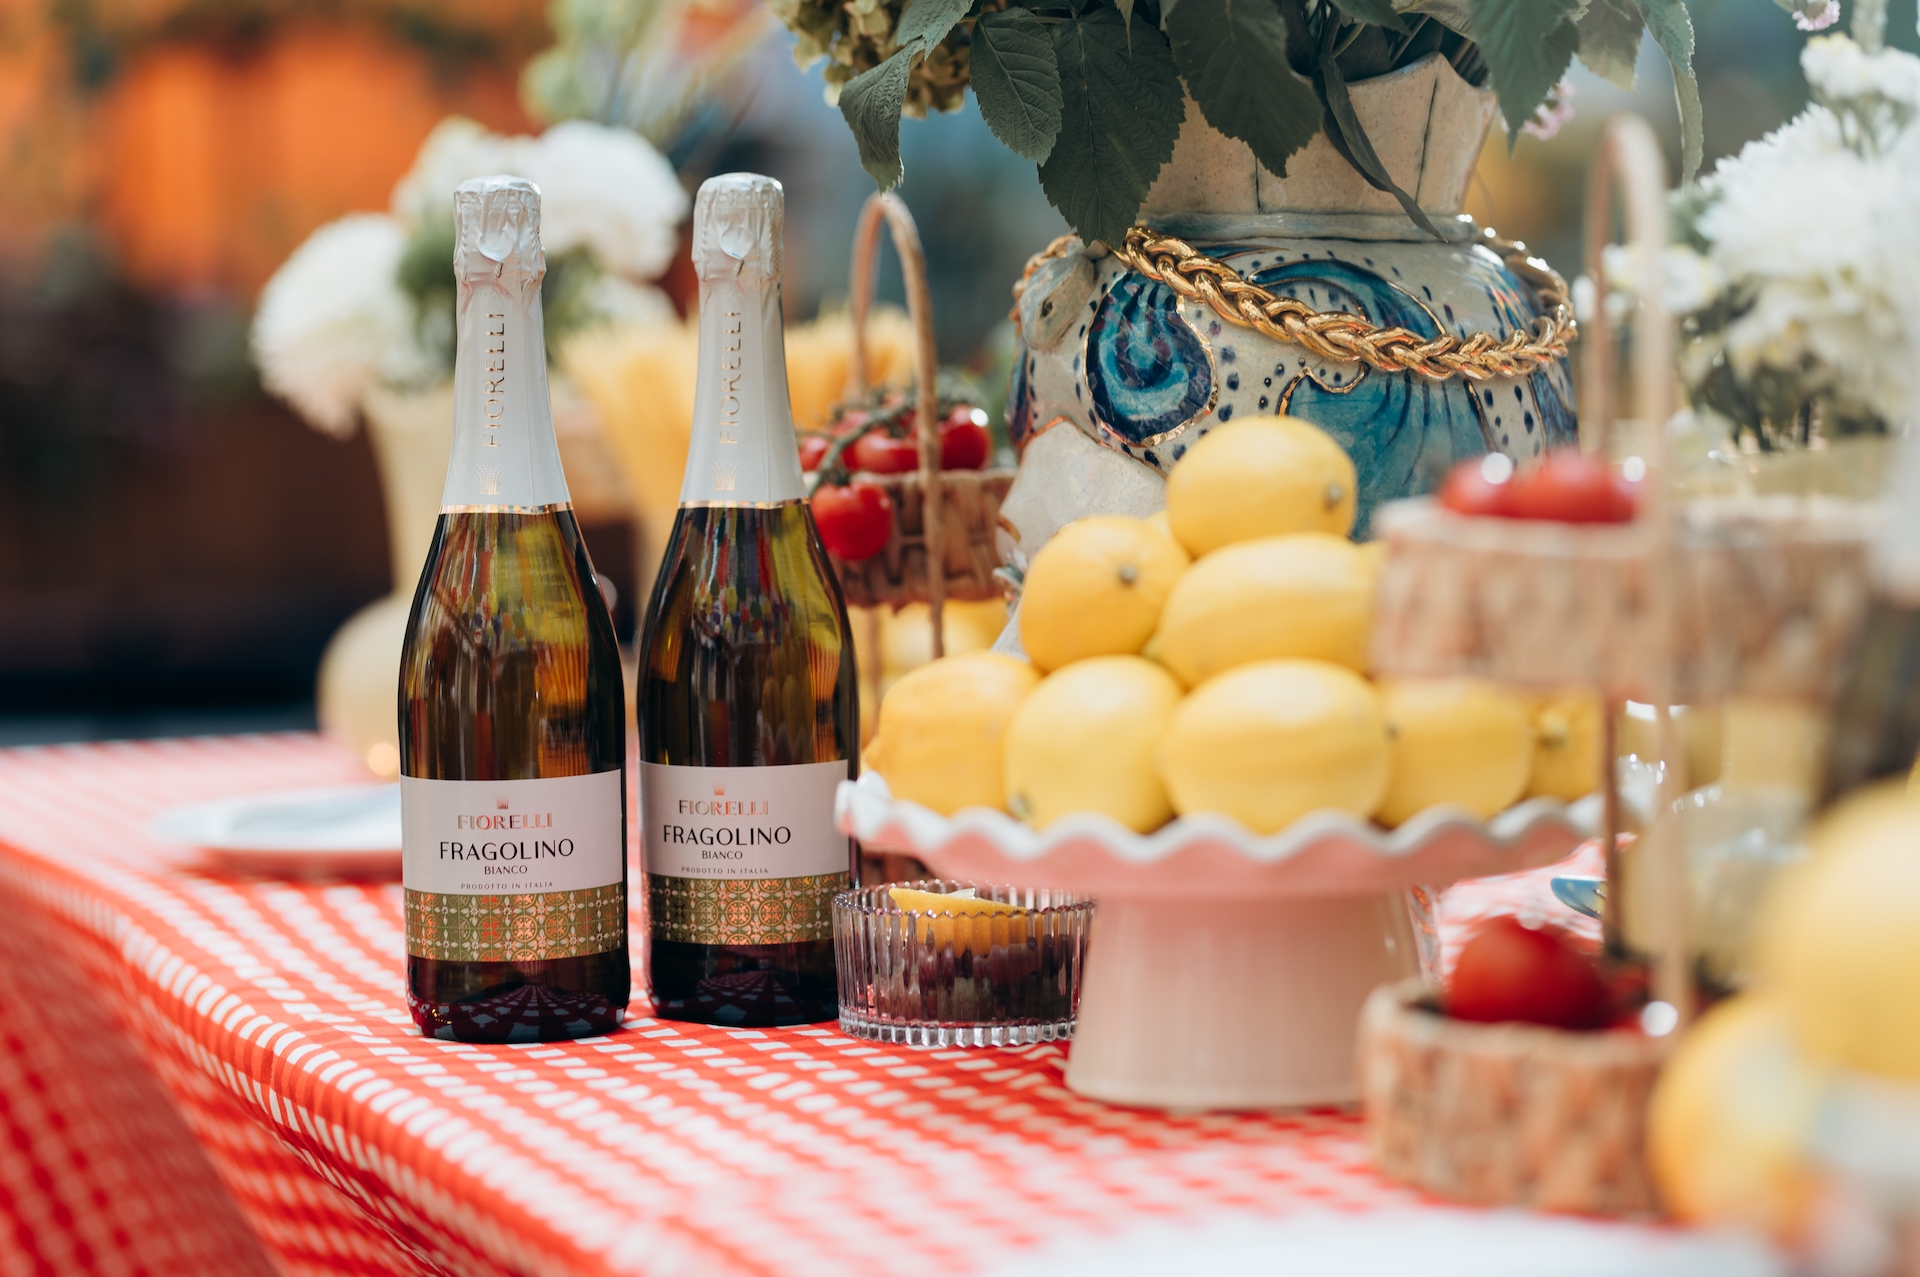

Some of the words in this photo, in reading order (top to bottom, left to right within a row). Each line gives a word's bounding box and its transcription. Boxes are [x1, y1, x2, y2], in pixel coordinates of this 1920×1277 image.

[483, 312, 505, 448] FIORELLI
[719, 311, 741, 444] FIORELLI
[678, 799, 769, 816] FIORELLI
[457, 812, 553, 830] FIORELLI
[663, 825, 791, 846] FRAGOLINO
[439, 838, 574, 861] FRAGOLINO
[701, 850, 743, 860] BIANCO
[484, 864, 528, 875] BIANCO
[681, 866, 724, 874] PRODOTTO
[525, 881, 553, 889] ITALIA
